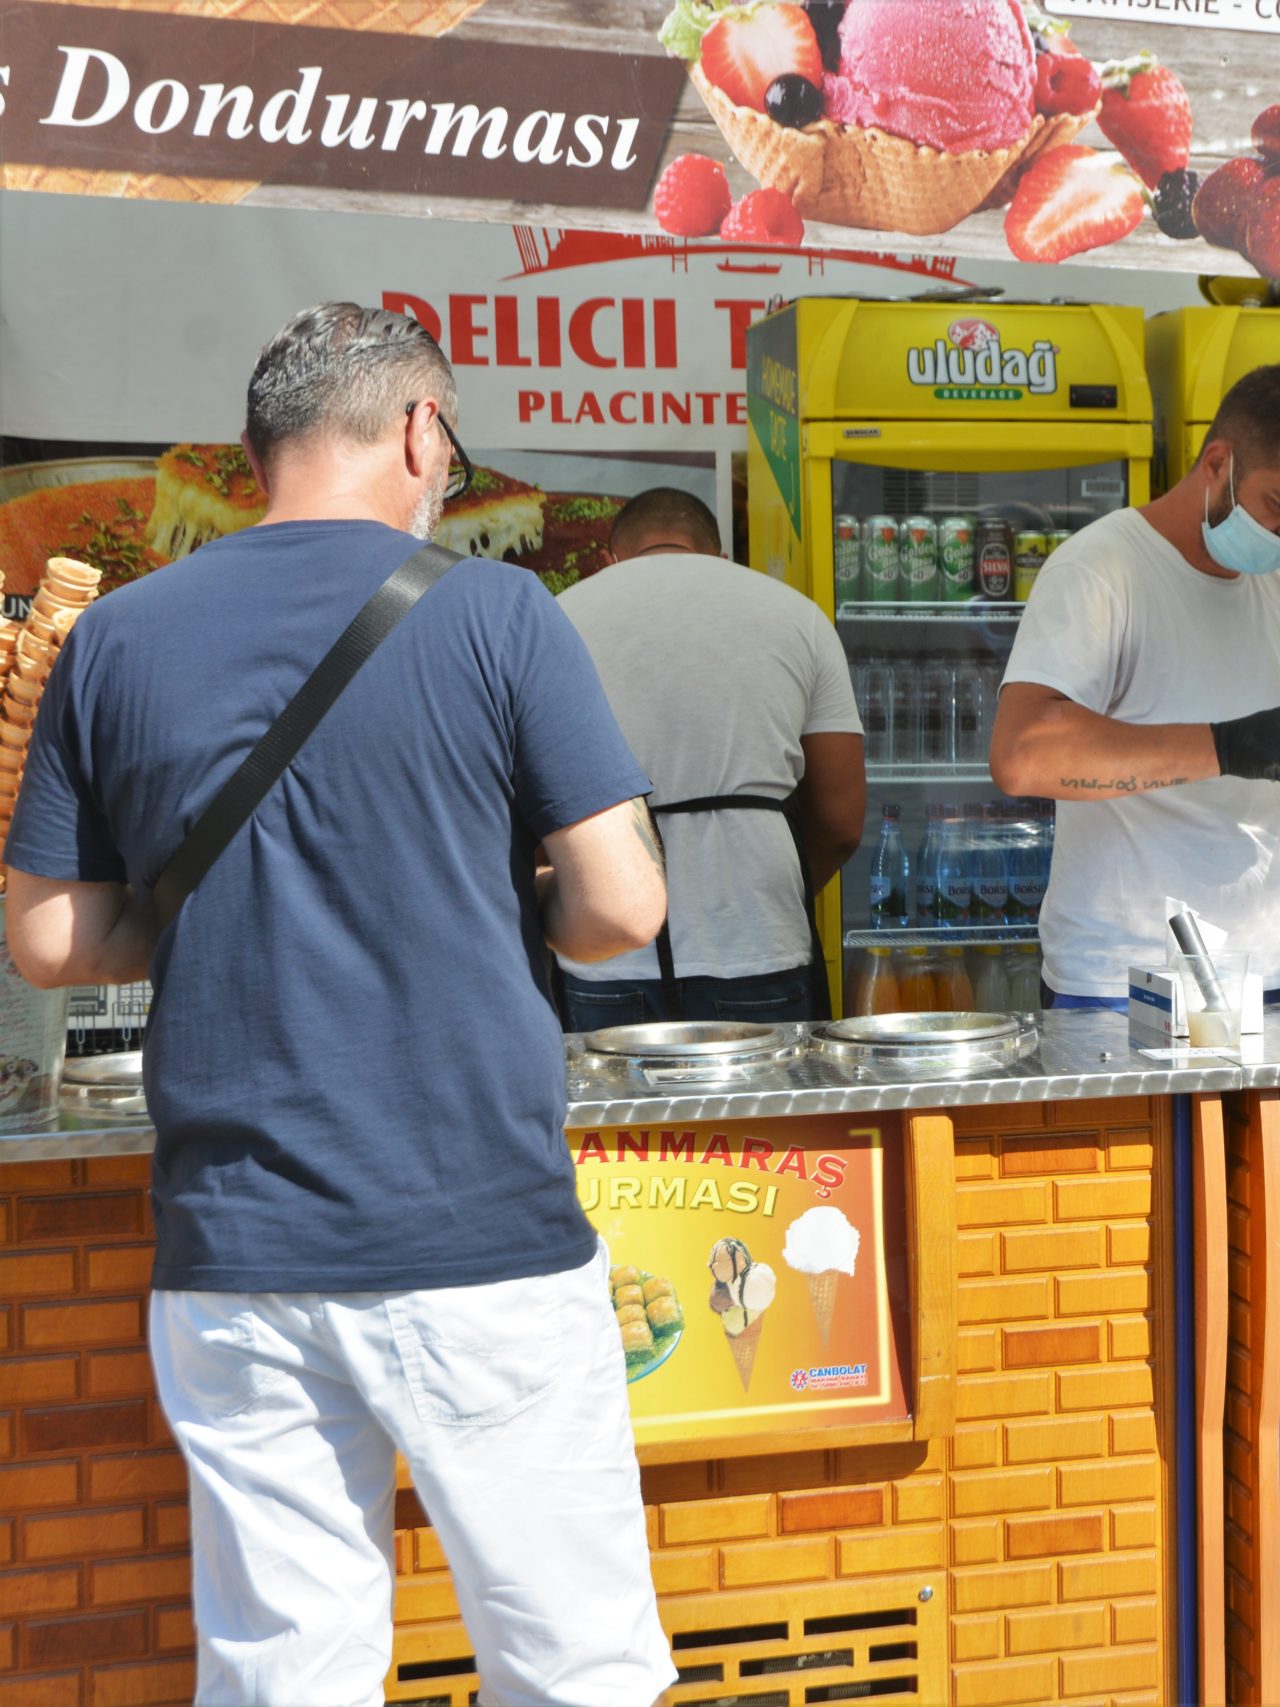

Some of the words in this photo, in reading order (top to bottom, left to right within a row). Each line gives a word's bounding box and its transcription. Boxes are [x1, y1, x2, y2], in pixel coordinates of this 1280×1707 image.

[39, 45, 640, 170] Dondurması
[518, 390, 747, 425] PLACINTE
[943, 389, 1015, 399] BEVERAGE
[576, 1129, 848, 1199] ANMARAŞ
[581, 1175, 779, 1217] URMASI
[809, 1364, 866, 1377] CANBOLAT
